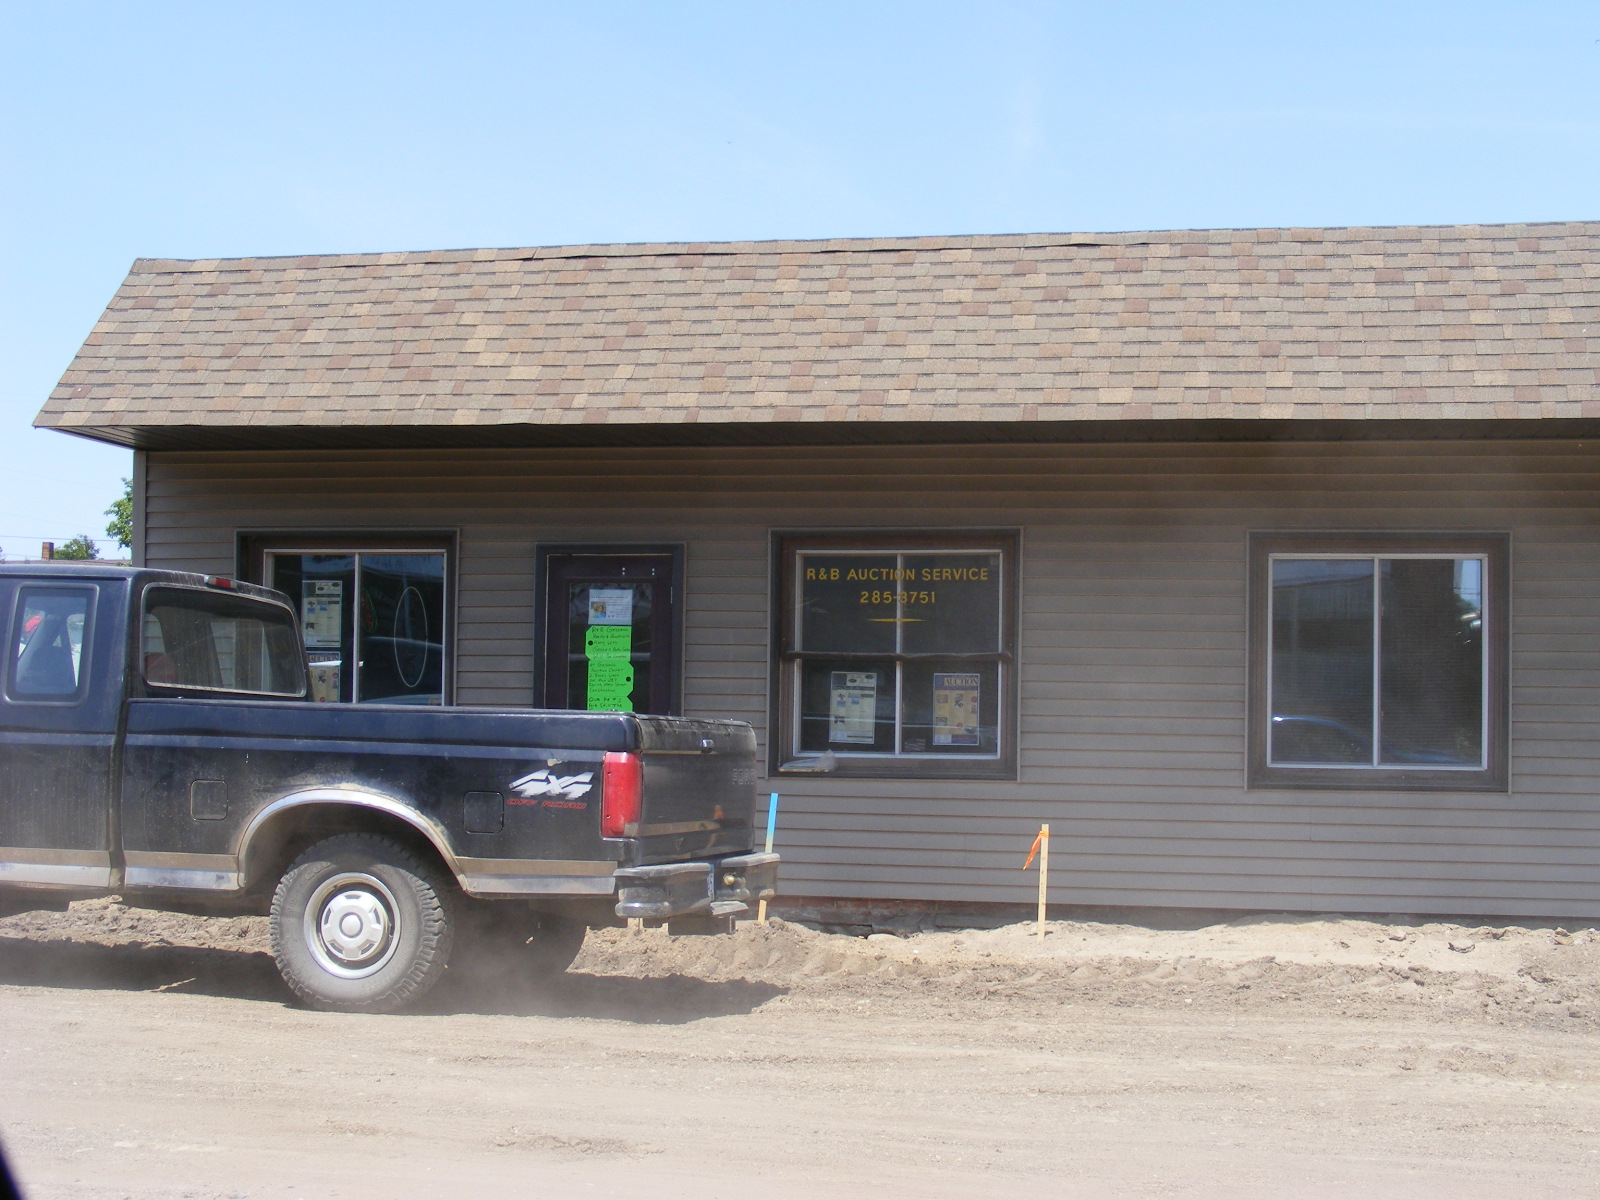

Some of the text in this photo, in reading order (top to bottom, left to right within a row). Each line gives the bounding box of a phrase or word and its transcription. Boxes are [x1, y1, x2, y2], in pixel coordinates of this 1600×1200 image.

[806, 568, 989, 582] R&B AUCTION SERVICE
[859, 590, 936, 604] 285-3751
[945, 677, 978, 687] AUCTION
[506, 798, 588, 810] OFF ROAD
